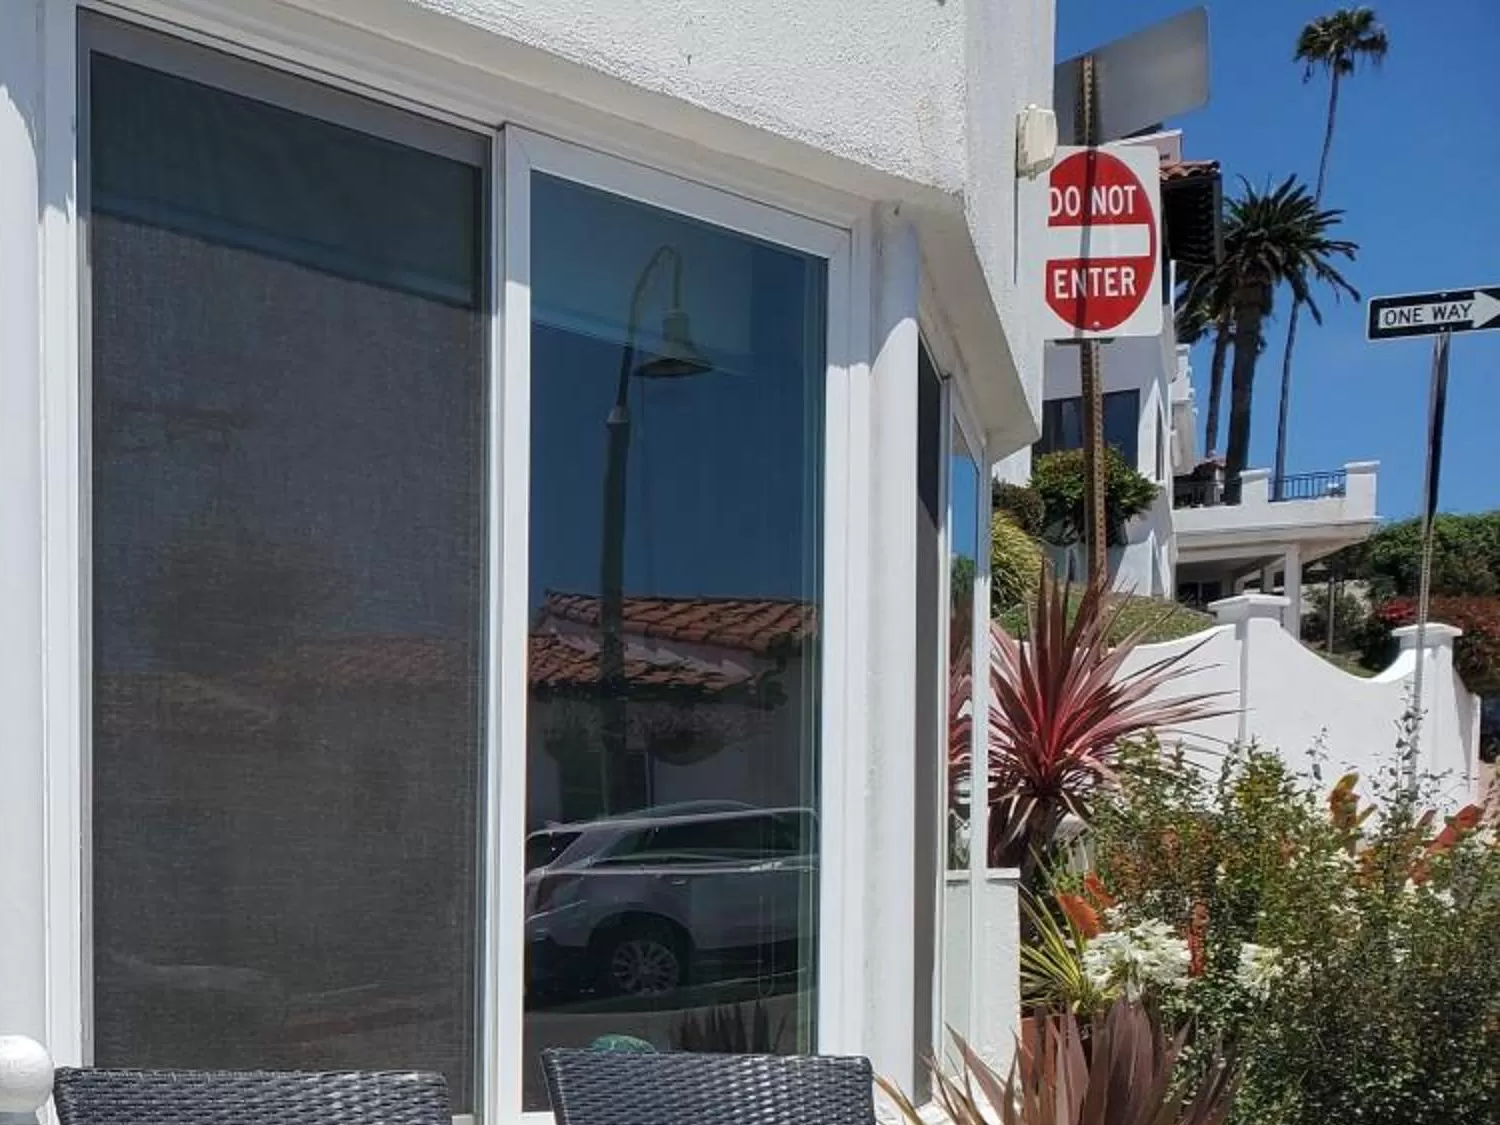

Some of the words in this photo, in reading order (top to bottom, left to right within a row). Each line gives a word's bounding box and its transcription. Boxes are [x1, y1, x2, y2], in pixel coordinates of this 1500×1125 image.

[1048, 187, 1081, 217] DO
[1091, 186, 1137, 216] NOT
[1054, 267, 1137, 299] ENTER
[1385, 307, 1422, 326] ONE
[1432, 303, 1473, 322] WAY
